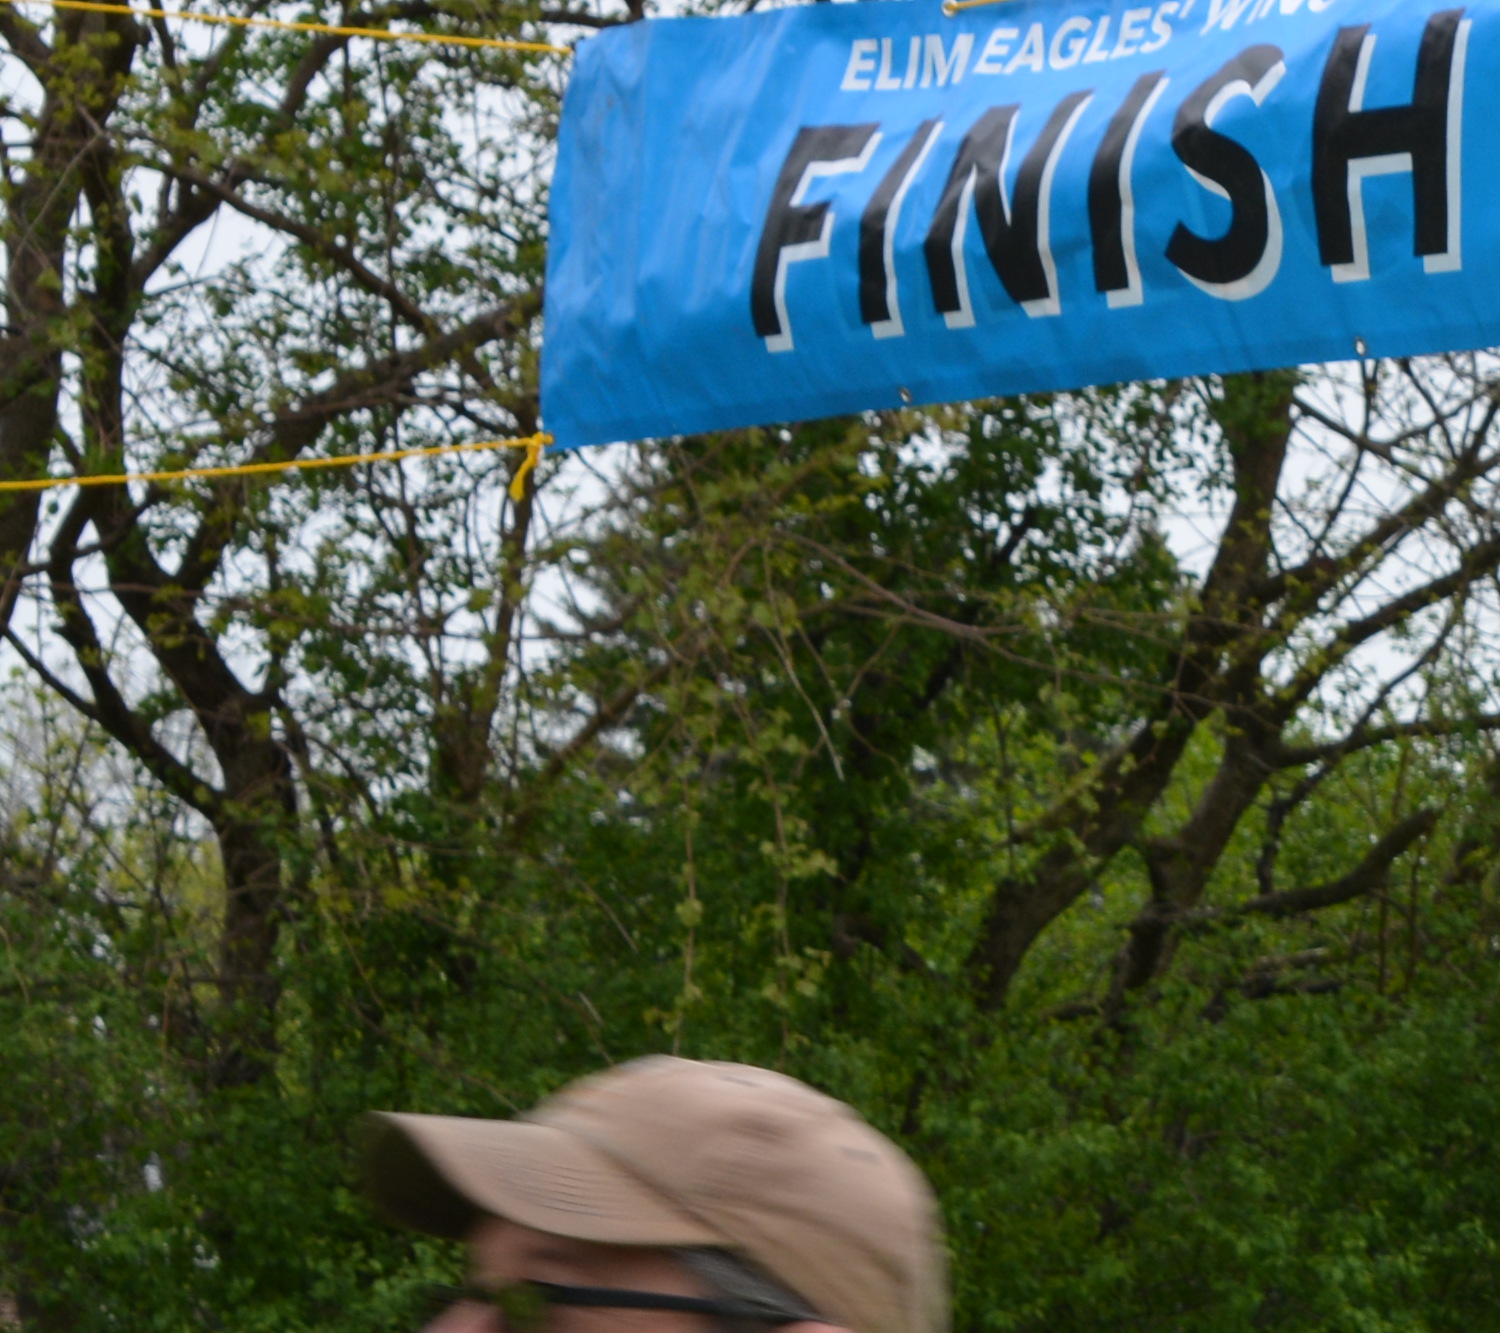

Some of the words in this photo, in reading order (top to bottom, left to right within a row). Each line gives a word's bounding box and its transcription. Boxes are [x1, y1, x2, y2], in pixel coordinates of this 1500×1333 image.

[840, 33, 974, 91] ELIM
[973, 0, 1195, 75] EAGLES'
[752, 8, 1471, 352] FINISH
